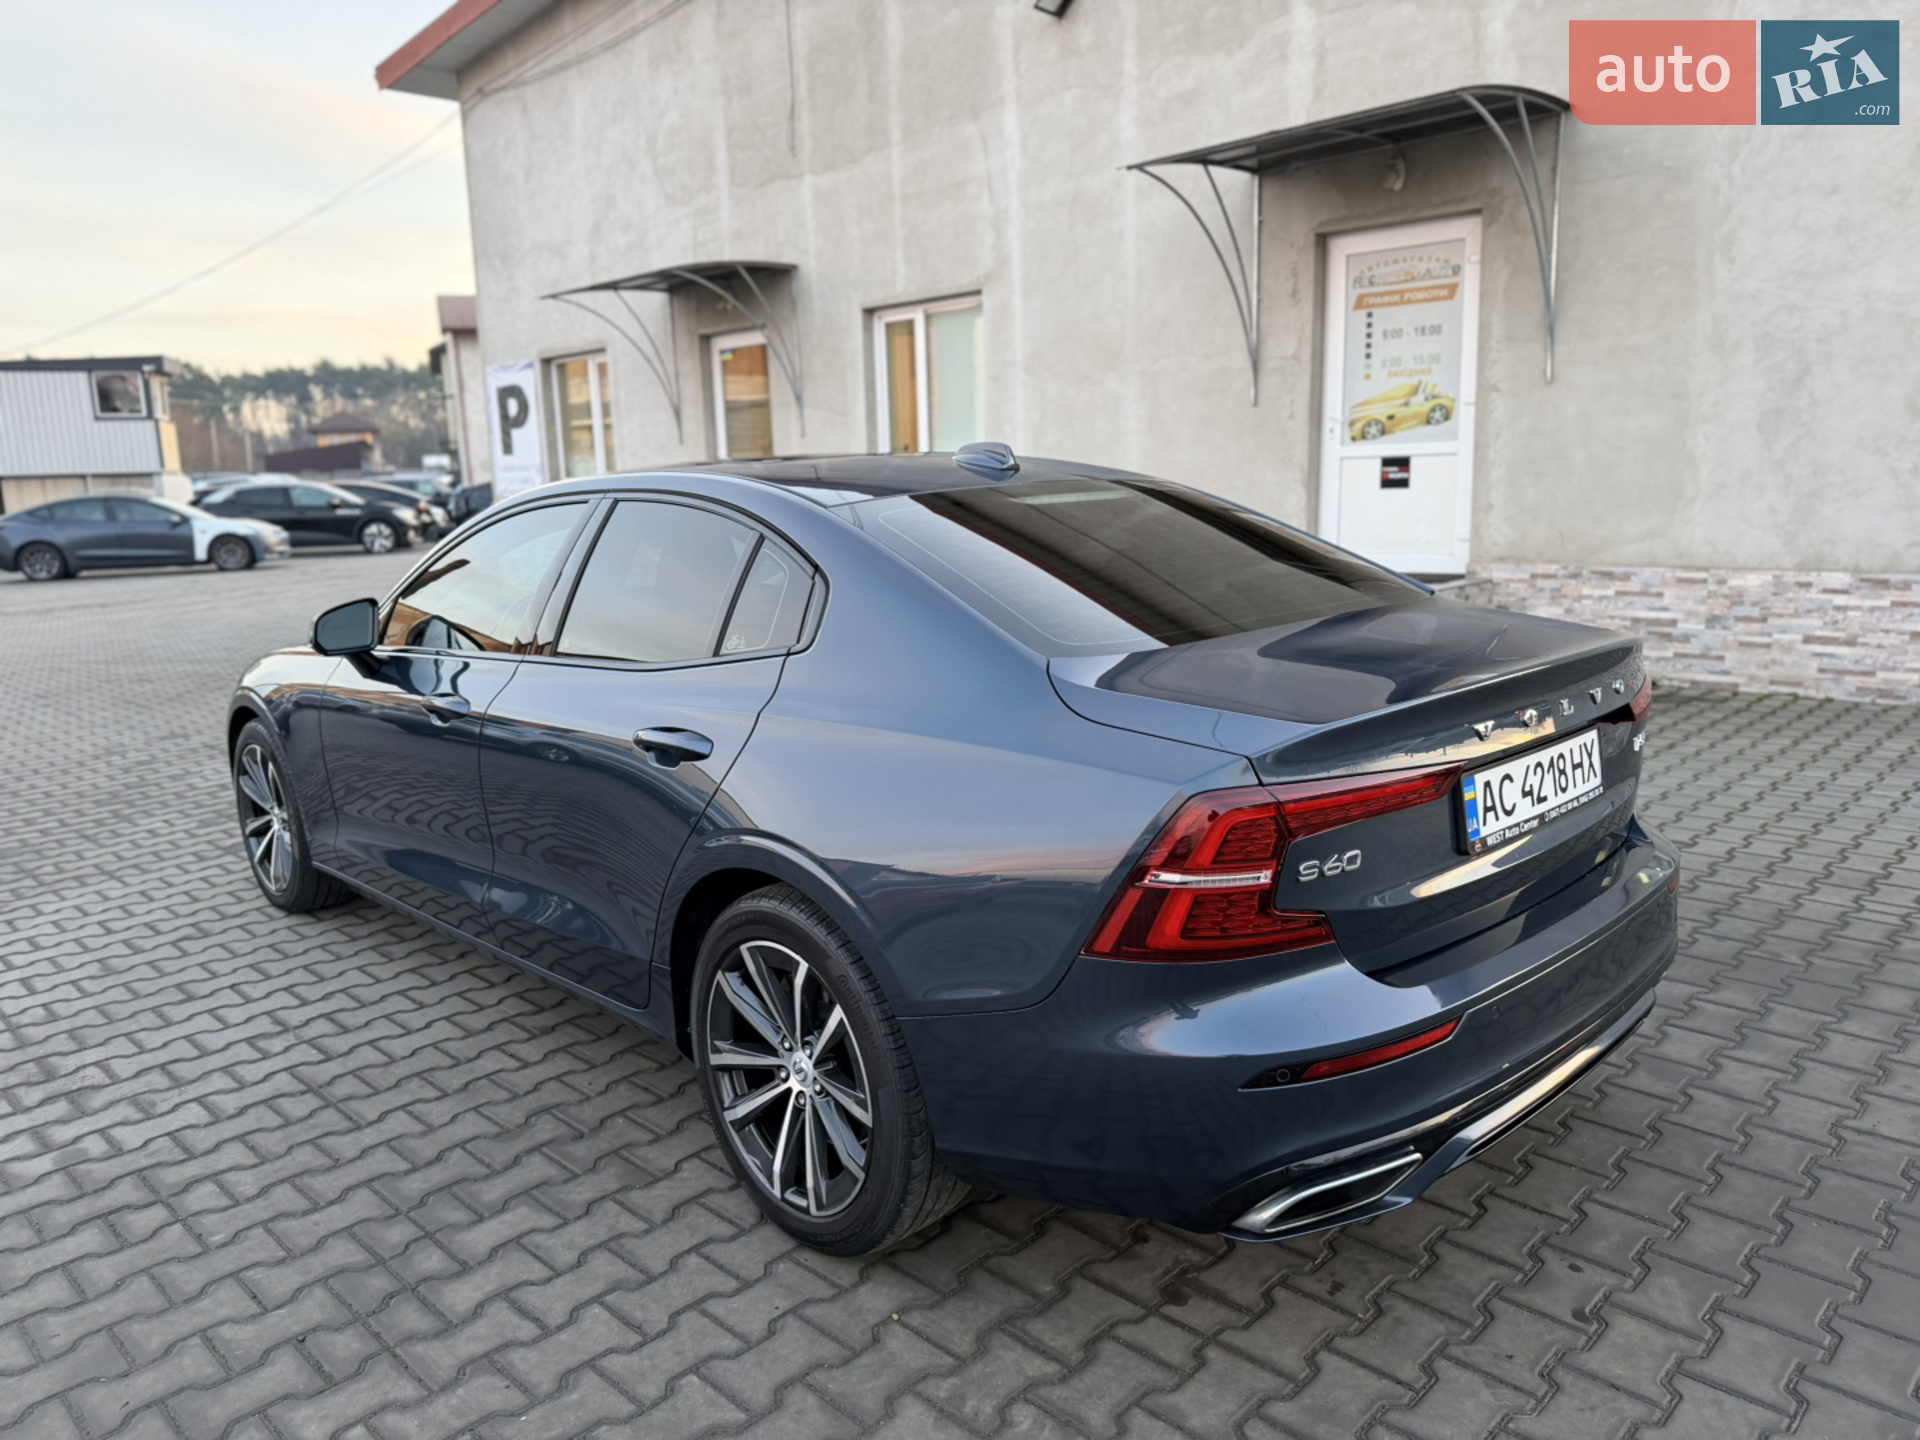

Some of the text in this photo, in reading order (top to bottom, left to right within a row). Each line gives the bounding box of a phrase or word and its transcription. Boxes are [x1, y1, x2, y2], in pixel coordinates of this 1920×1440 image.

[1471, 678, 1626, 742] VOLVO
[1482, 772, 1516, 827] AC
[1521, 751, 1569, 808] 4218
[1569, 738, 1598, 789] HX
[1486, 830, 1505, 847] WEST
[1505, 826, 1520, 840] Auto
[1520, 818, 1540, 833] Center
[1296, 849, 1362, 882] S60
